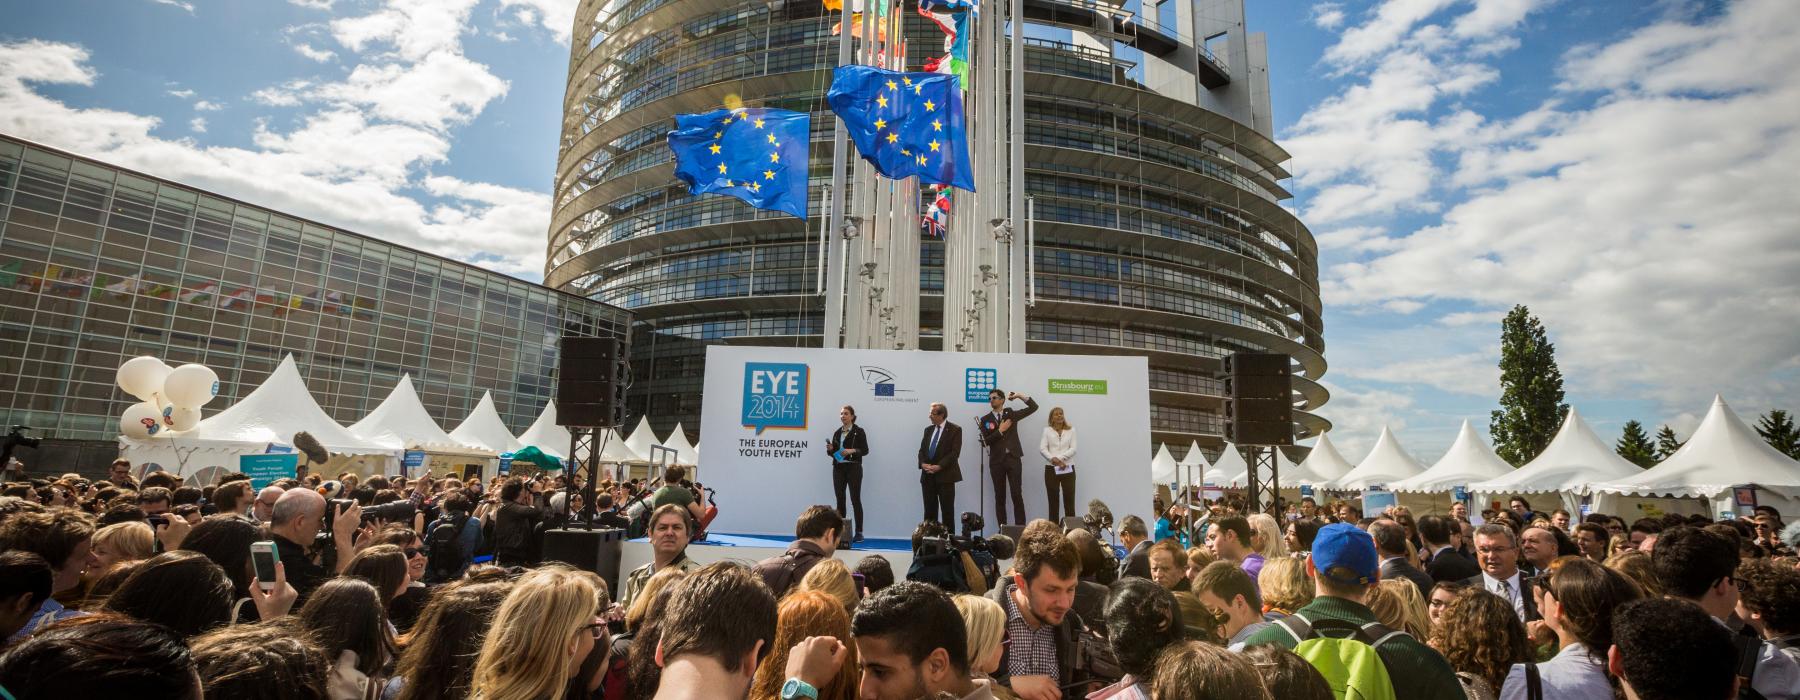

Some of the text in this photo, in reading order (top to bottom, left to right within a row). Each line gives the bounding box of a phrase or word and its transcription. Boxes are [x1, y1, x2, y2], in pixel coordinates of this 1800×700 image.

[751, 370, 800, 395] EYE
[748, 394, 800, 418] 2014
[739, 439, 808, 449] THE EUROPEAN
[739, 449, 803, 458] YOUTH EVENT
